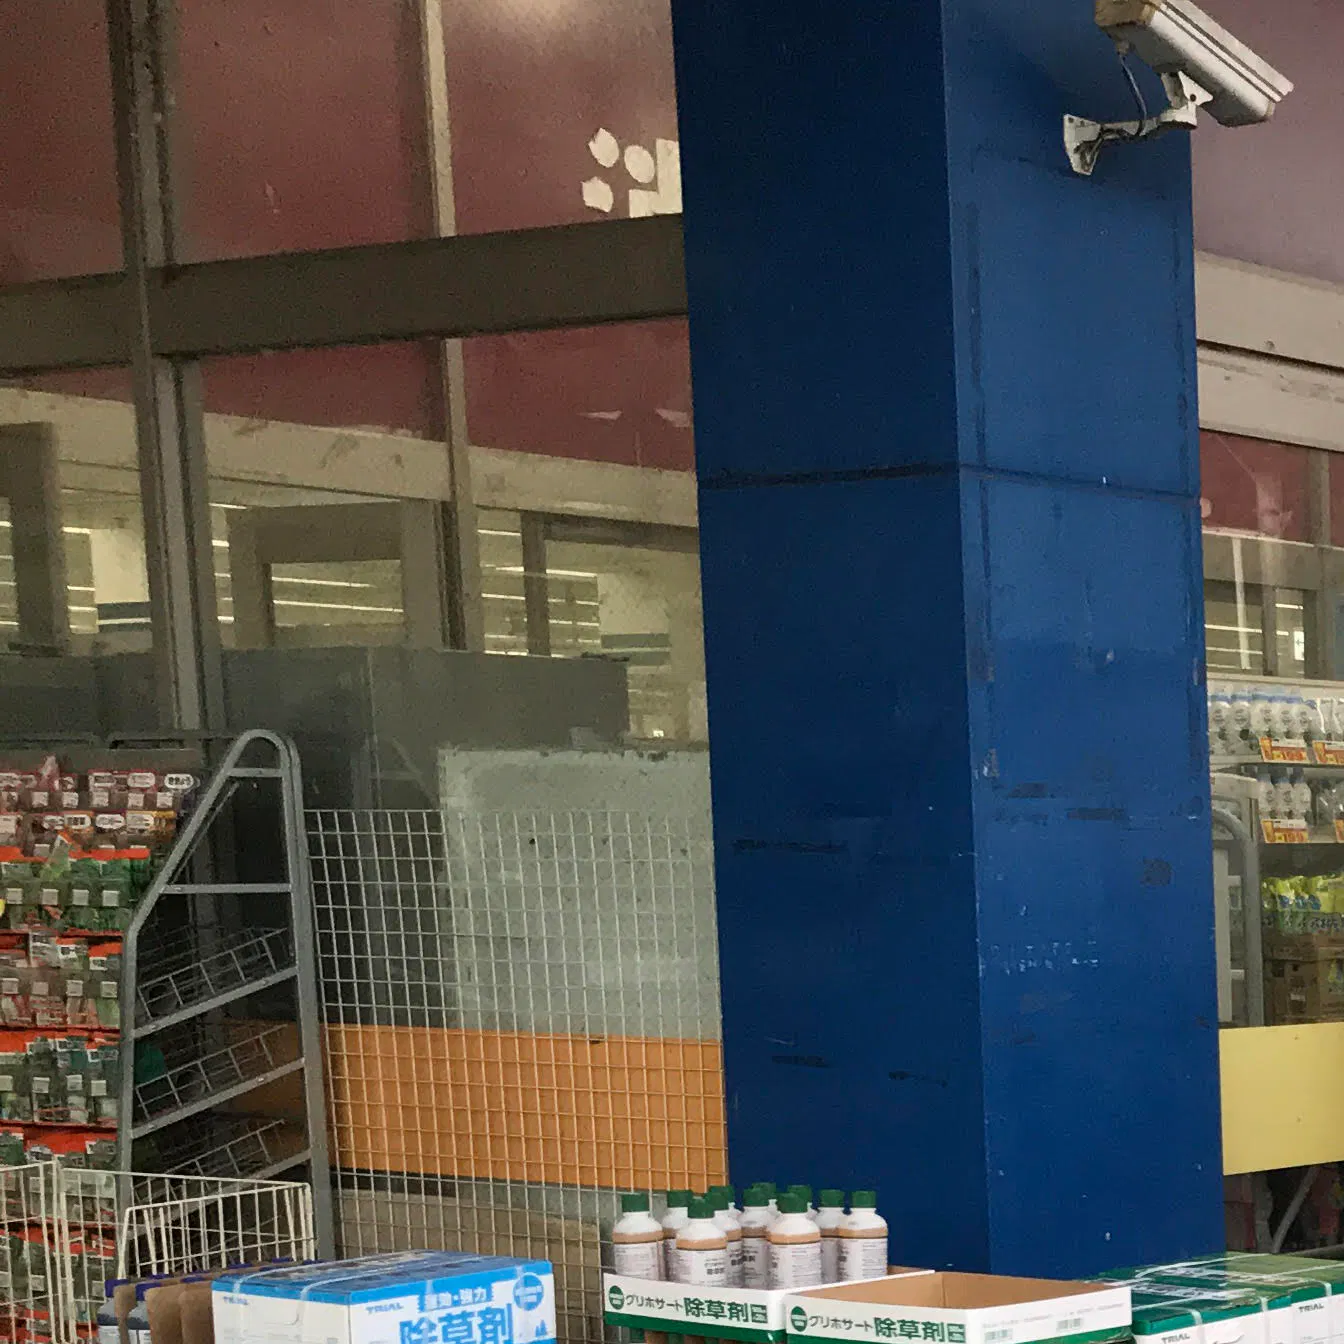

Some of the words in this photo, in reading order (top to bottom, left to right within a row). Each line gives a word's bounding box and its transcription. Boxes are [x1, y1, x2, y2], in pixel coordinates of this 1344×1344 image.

[365, 1301, 405, 1315] TRIAL
[626, 1293, 749, 1324] グリホサート除草剤
[1298, 1302, 1325, 1313] TRIAL
[809, 1315, 946, 1344] グリホサート除草剤
[1160, 1332, 1191, 1344] TRIAL
